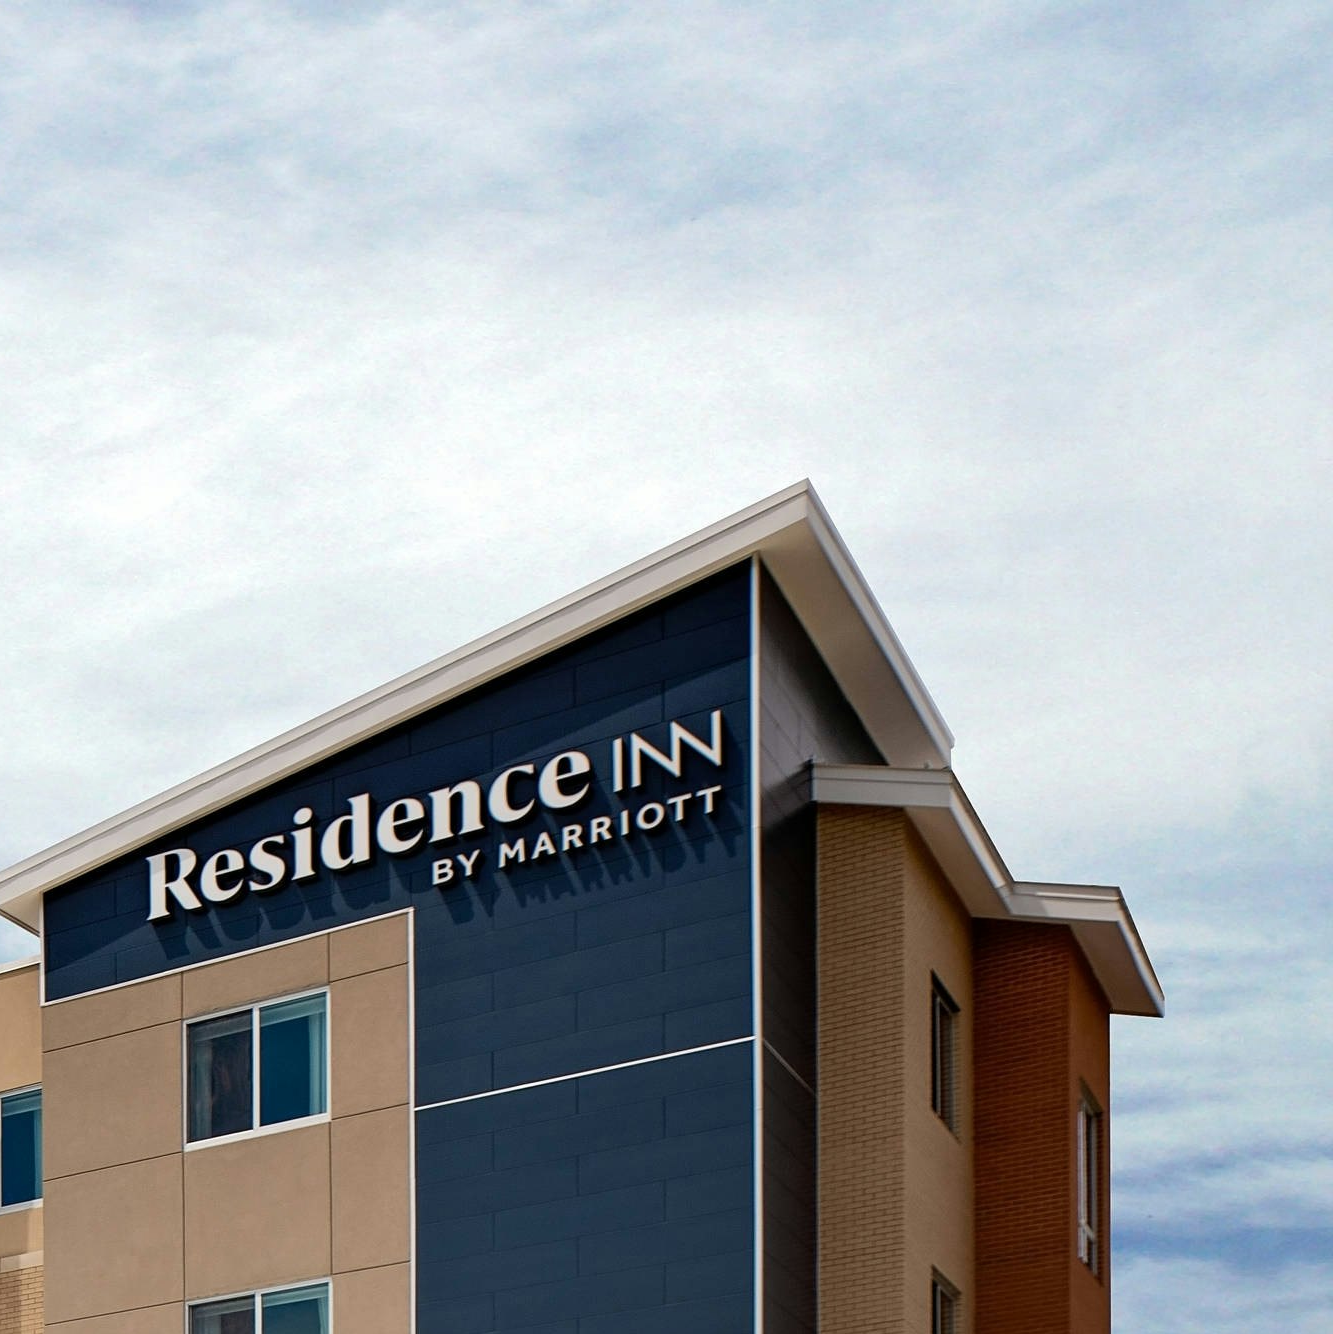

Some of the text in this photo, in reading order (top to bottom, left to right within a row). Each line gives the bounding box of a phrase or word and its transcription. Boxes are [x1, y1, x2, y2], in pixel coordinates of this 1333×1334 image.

[145, 709, 722, 922] Residence INN
[431, 784, 722, 886] BY MARRIOTT
